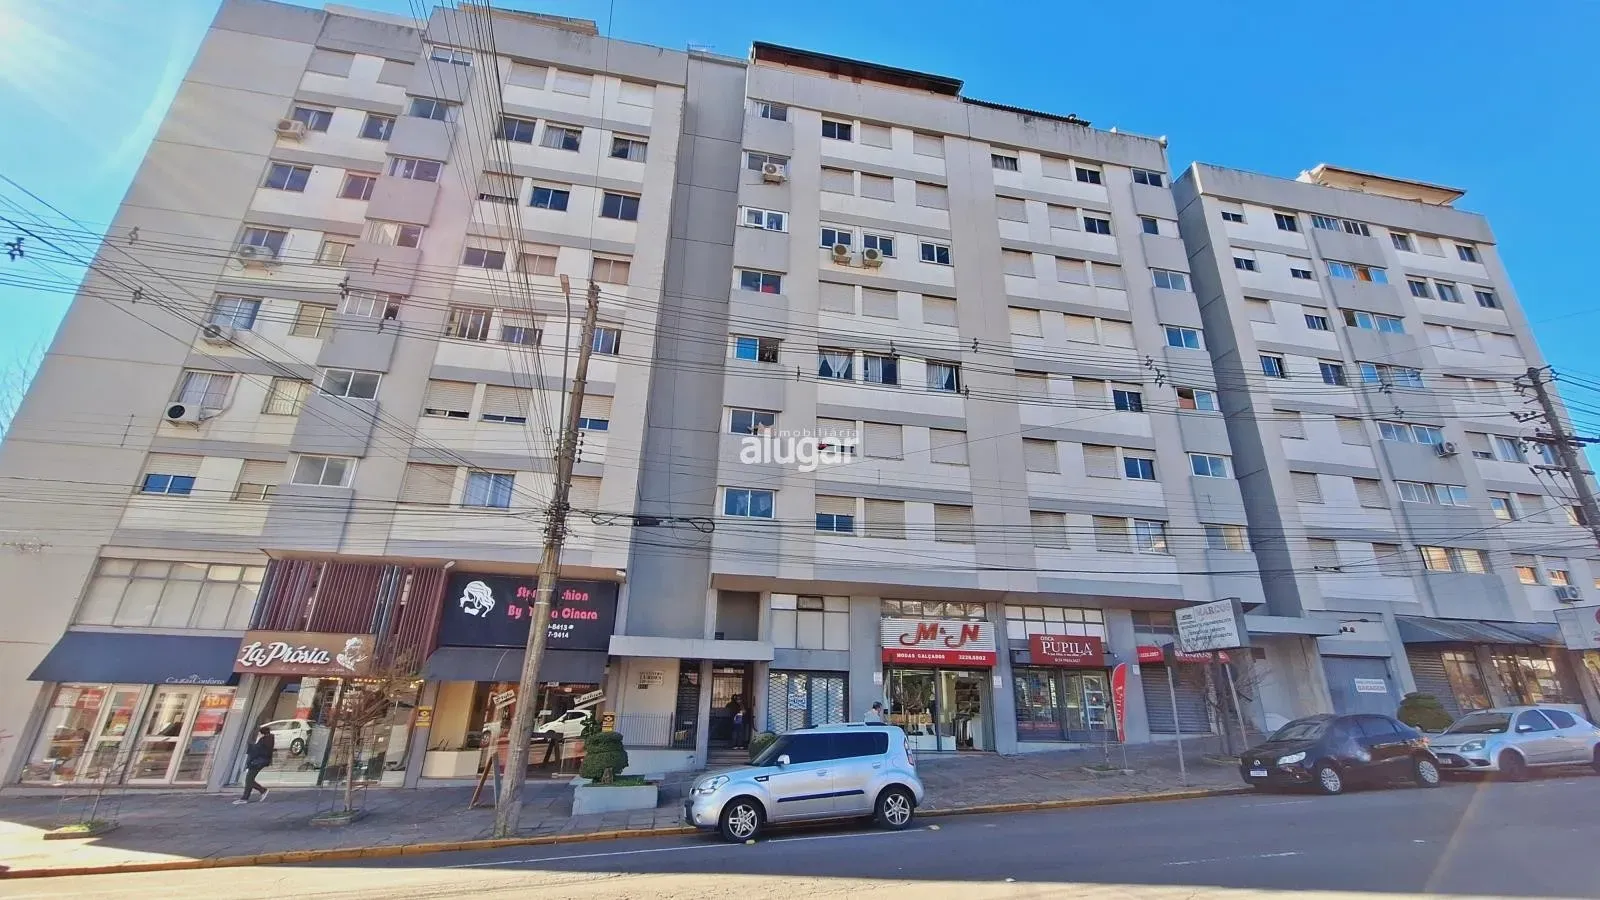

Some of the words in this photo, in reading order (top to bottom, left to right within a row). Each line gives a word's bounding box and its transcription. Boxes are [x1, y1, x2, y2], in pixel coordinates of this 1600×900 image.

[508, 605, 522, 619] By
[562, 608, 598, 619] Cinara
[260, 642, 330, 667] Prósia
[1042, 641, 1093, 656] PUPILA
